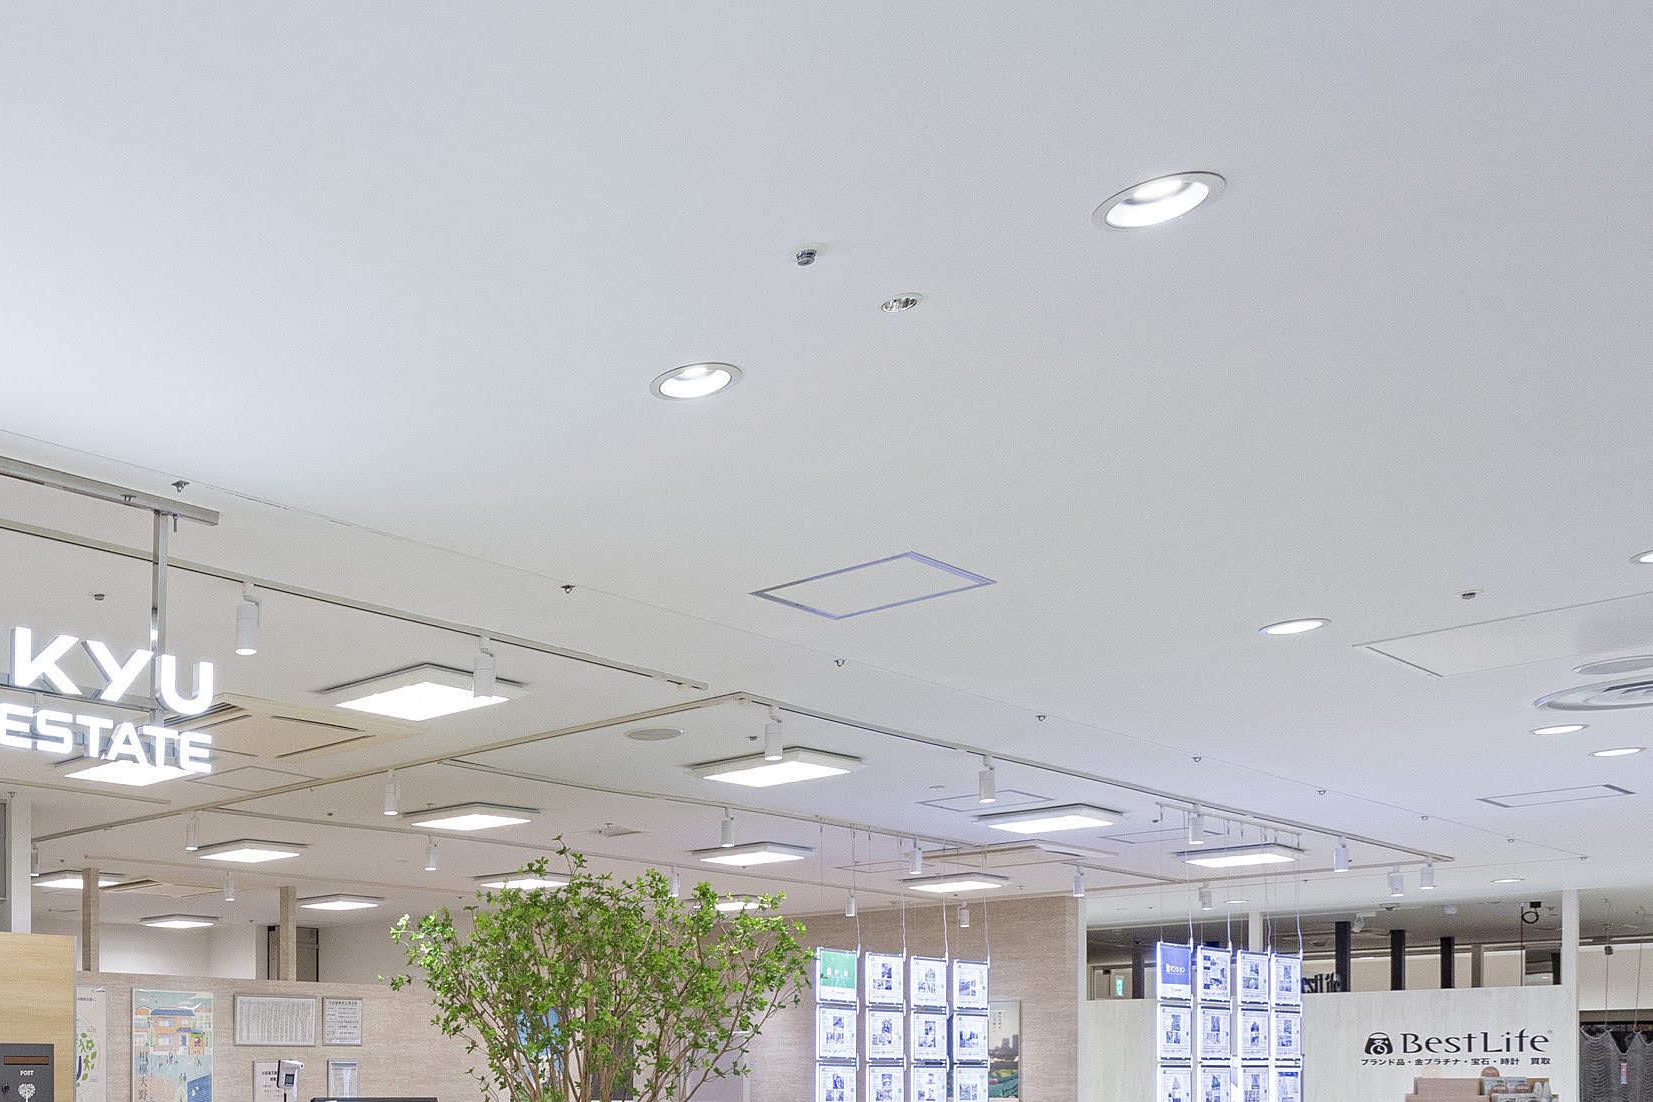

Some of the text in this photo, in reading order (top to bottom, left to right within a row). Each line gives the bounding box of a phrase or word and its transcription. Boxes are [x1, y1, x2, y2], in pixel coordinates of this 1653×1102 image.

[1400, 1028, 1550, 1054] BestLife
[1361, 1057, 1551, 1066] ブランド品・金プラチナ・宝石・時計 買取
